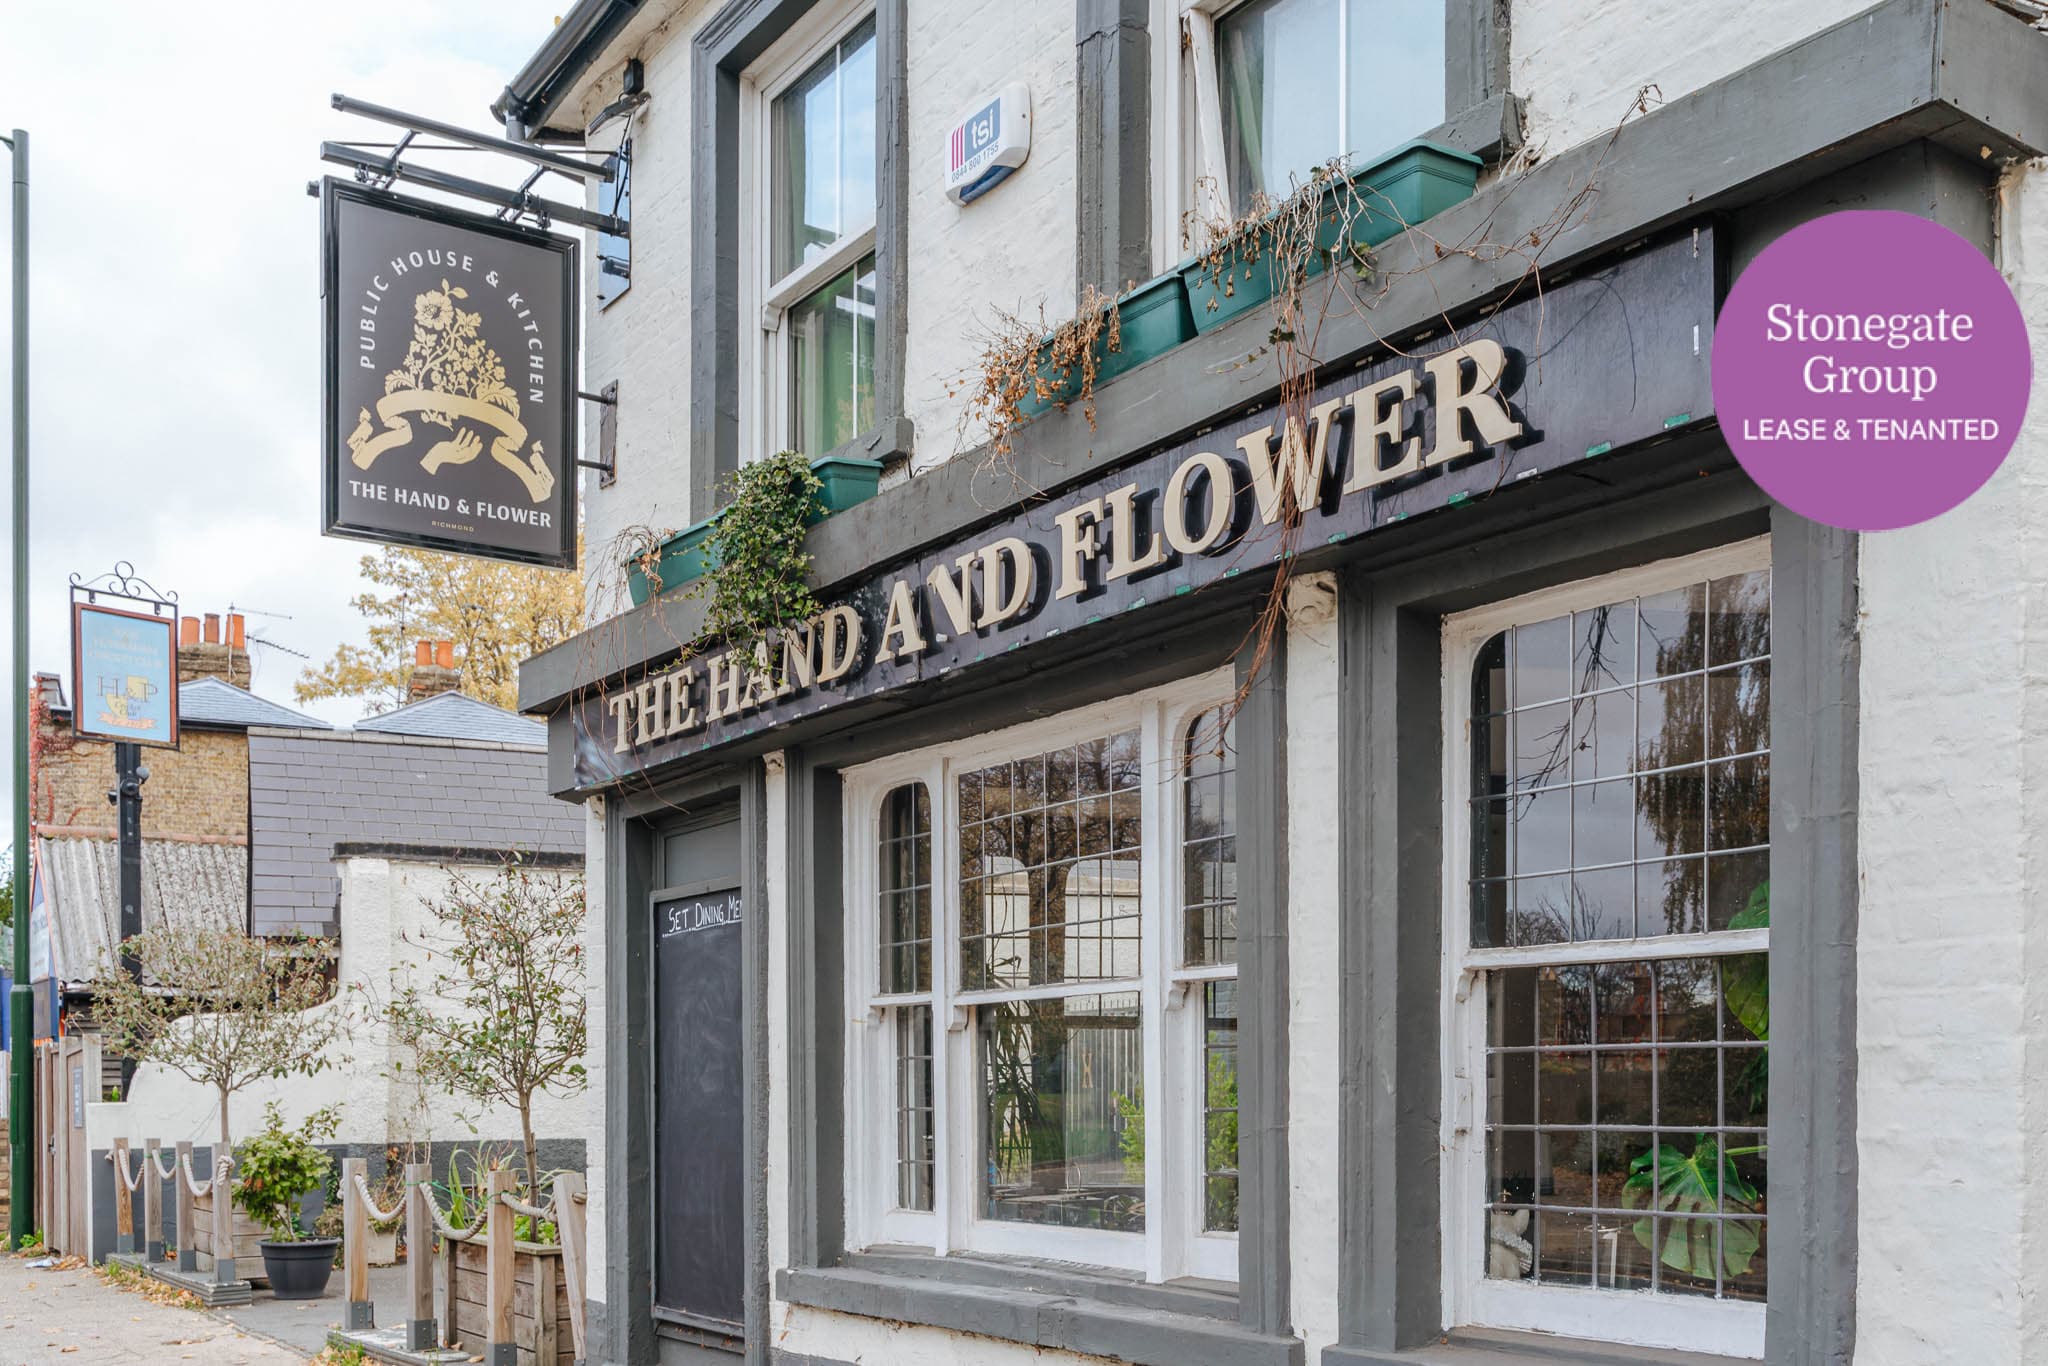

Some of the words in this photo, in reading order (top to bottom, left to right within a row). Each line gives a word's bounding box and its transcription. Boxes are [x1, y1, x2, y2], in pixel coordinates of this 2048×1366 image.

[952, 164, 967, 183] 0844
[969, 154, 981, 170] 800
[984, 143, 999, 160] 1755
[360, 275, 389, 369] PUBLIC
[391, 249, 473, 276] HOUSE
[485, 270, 499, 288] &
[507, 292, 544, 404] KITCHEN
[349, 480, 388, 501] THE
[394, 487, 450, 511] HAND
[456, 498, 470, 515] &
[476, 501, 552, 528] FLOWER
[431, 519, 475, 533] RICHMOND
[609, 665, 700, 755] THE
[706, 604, 864, 723] HAND
[874, 538, 1034, 665] AND
[1054, 338, 1524, 601] FLOWER
